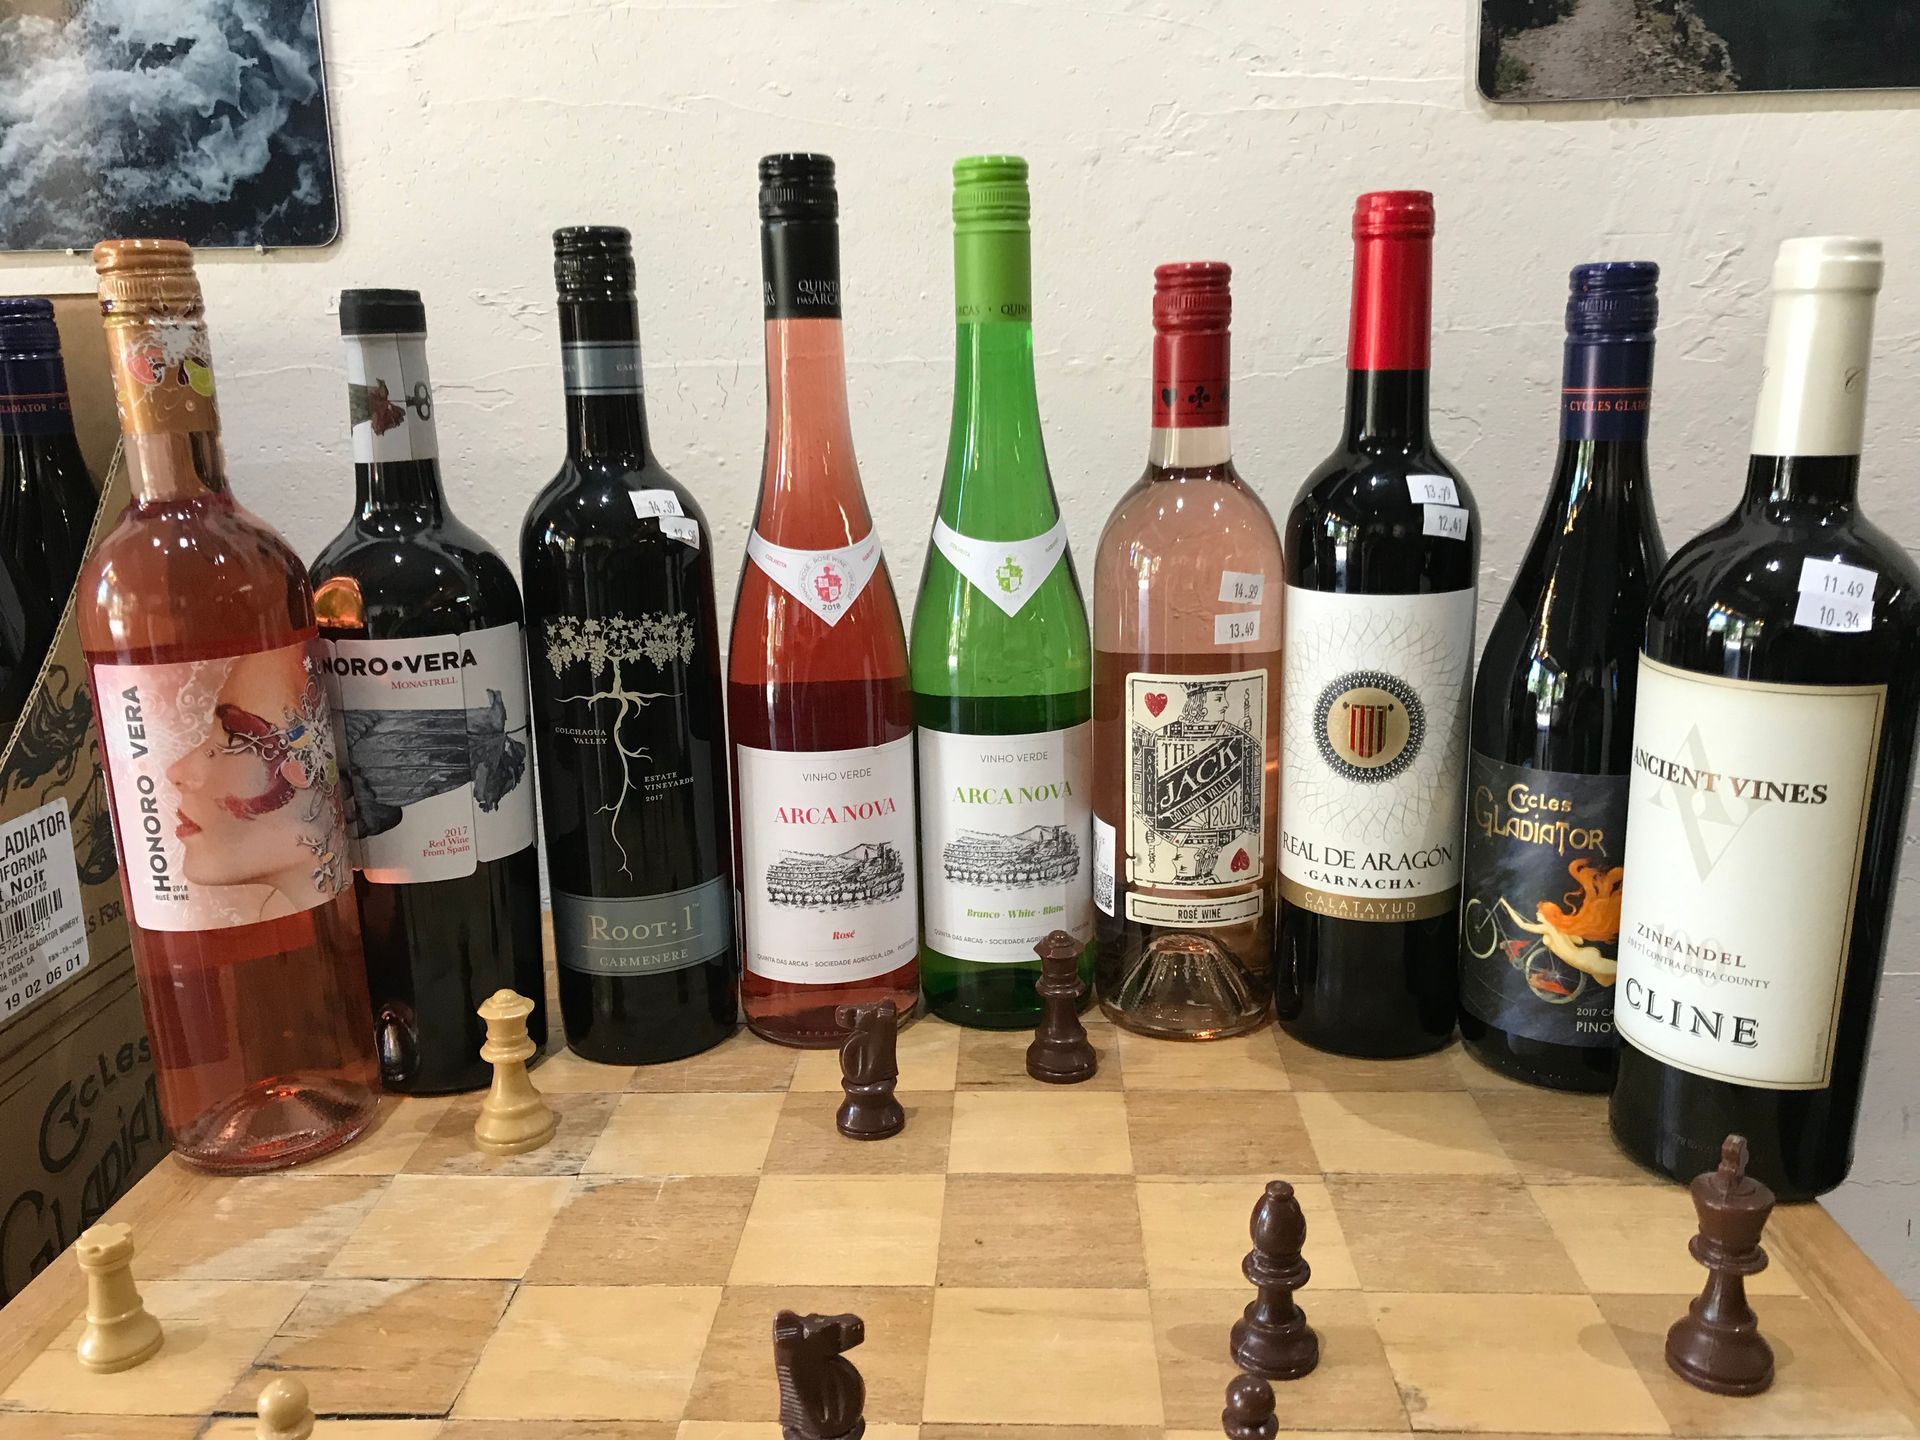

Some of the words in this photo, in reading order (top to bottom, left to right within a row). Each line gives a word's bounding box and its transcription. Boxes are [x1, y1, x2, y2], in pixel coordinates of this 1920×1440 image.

[1569, 400, 1611, 411] CYCLES
[649, 500, 675, 514] 14.39
[1234, 583, 1259, 599] 14.99
[1824, 575, 1864, 598] 11.49
[822, 603, 841, 611] 2018
[1820, 606, 1860, 629] 10.34
[1230, 622, 1255, 638] 13.49
[391, 677, 458, 690] MONASTRELL
[122, 686, 149, 759] VERA
[555, 727, 607, 736] COLCHAGUA
[573, 737, 607, 745] VALLEY
[980, 754, 1013, 763] VINHO
[1016, 751, 1049, 762] VERDE
[1162, 742, 1195, 771] THE
[644, 771, 678, 783] ESTATE
[802, 772, 837, 782] VINHO
[840, 768, 872, 780] VERDE
[1160, 737, 1239, 808] JACK
[1633, 745, 1721, 793] ANCIENT
[1729, 775, 1828, 805] VINES
[644, 777, 694, 791] VINEYARDS
[646, 794, 663, 802] 2017
[952, 787, 1014, 804] ARCA
[1018, 781, 1073, 803] NOVA
[1170, 797, 1207, 823] COLUMBIA
[1207, 775, 1234, 800] VALLEY
[774, 807, 838, 824] ARCA
[842, 797, 897, 821] NOVA
[1212, 791, 1239, 827] 2018
[0, 811, 67, 862] ADIATOR
[137, 775, 171, 892] HONORO
[445, 826, 468, 838] 2017
[429, 839, 446, 848] Red
[448, 837, 469, 845] Wine
[423, 849, 445, 857] From
[447, 845, 470, 855] Spain
[1283, 831, 1319, 862] REAL
[1324, 847, 1356, 869] DE
[1361, 843, 1453, 871] ARAGÓN
[10, 869, 46, 896] Noir
[1305, 891, 1417, 913] CALATAYUD
[967, 908, 1000, 919] Branco
[1007, 908, 1035, 919] White
[1042, 904, 1064, 915] Blanc
[1178, 907, 1198, 920] ROSÉ
[1202, 908, 1221, 919] WINE
[832, 929, 856, 940] Rosé
[952, 934, 962, 942] DAS
[963, 936, 983, 944] ARCAS
[989, 937, 1025, 945] SOCIEDADE
[1637, 922, 1746, 968] ZINFANDEL
[600, 949, 689, 967] CARMENERE
[757, 953, 776, 963] QUINTA
[814, 959, 851, 967] SOCIEDADE
[1646, 949, 1681, 970] CONTRA
[1683, 965, 1717, 980] COSTA
[1719, 973, 1771, 989] COUNTY
[4, 993, 21, 1011] 19
[25, 979, 42, 998] 02
[46, 966, 62, 985] 06
[66, 953, 81, 972] 01
[1576, 1008, 1597, 1016] 2017
[1626, 977, 1759, 1048] CLINE
